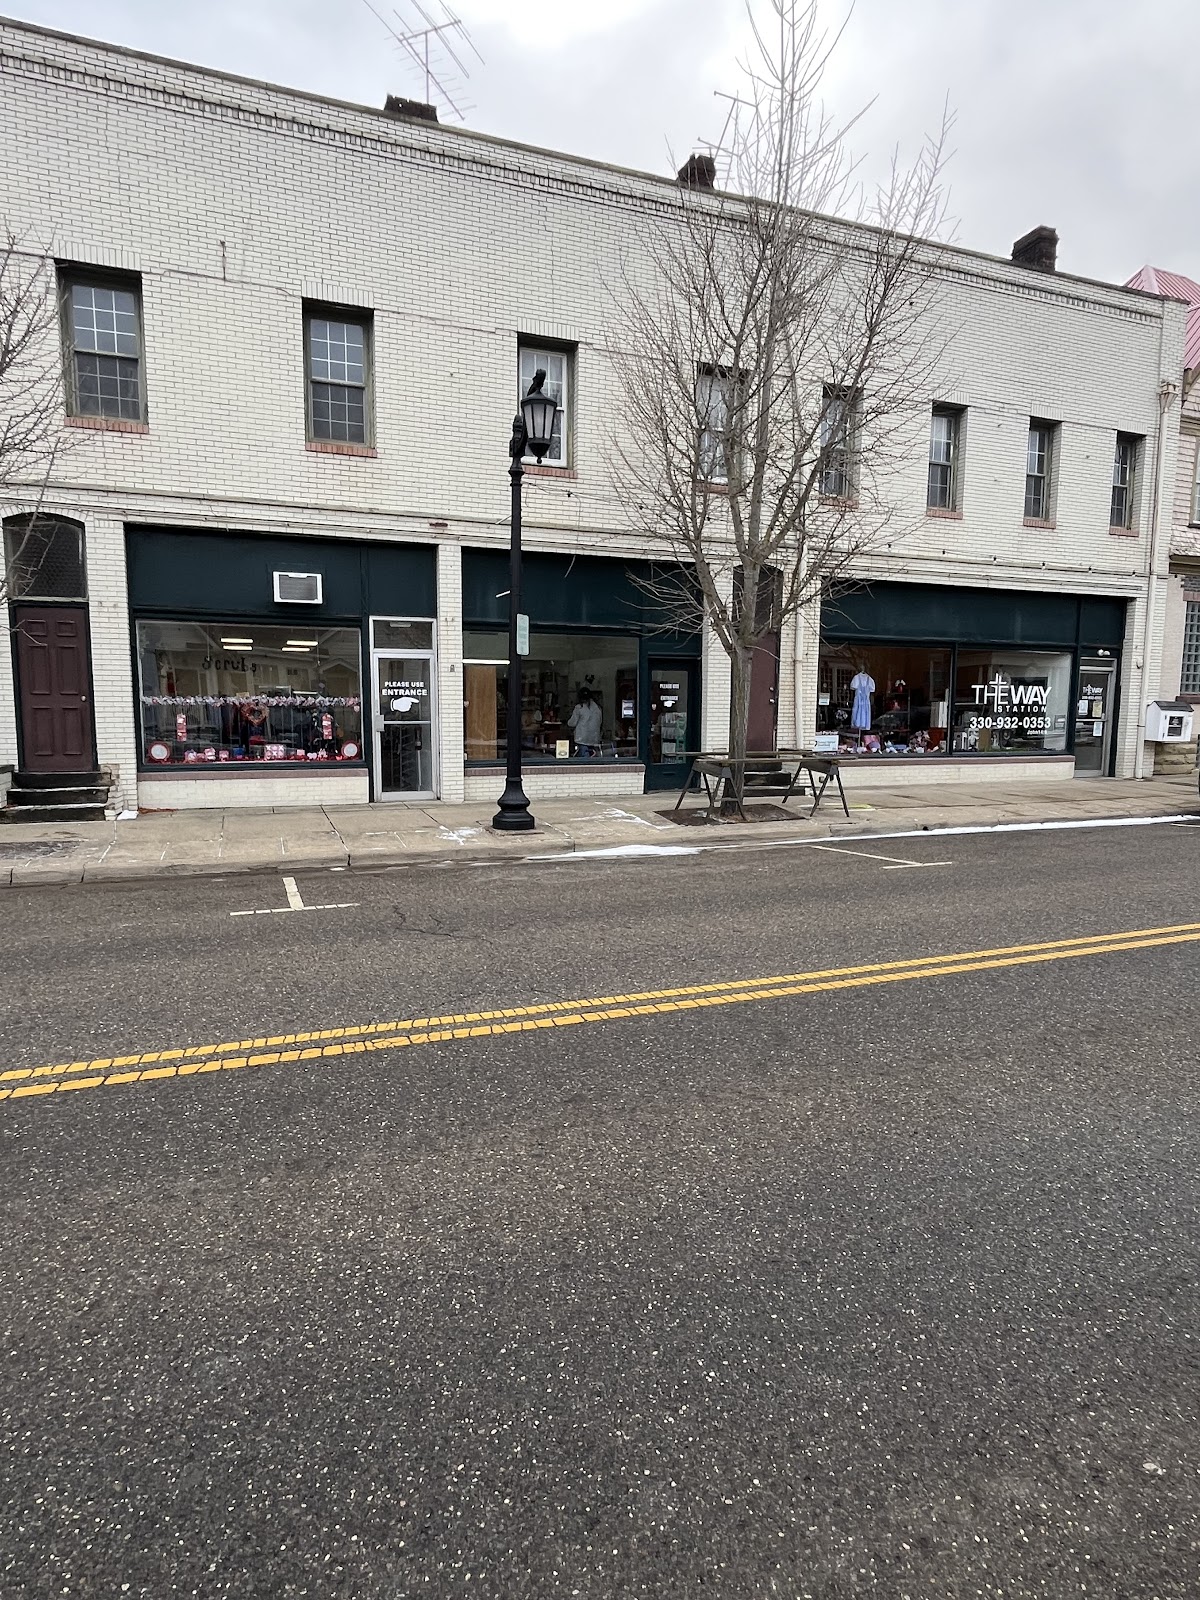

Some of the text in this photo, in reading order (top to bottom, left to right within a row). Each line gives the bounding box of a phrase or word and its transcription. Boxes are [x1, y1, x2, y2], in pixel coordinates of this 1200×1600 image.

[381, 688, 428, 696] ENTRANCE
[971, 675, 1052, 712] THE WAY
[998, 705, 1047, 713] STATION
[969, 716, 1051, 729] 330-932-0353
